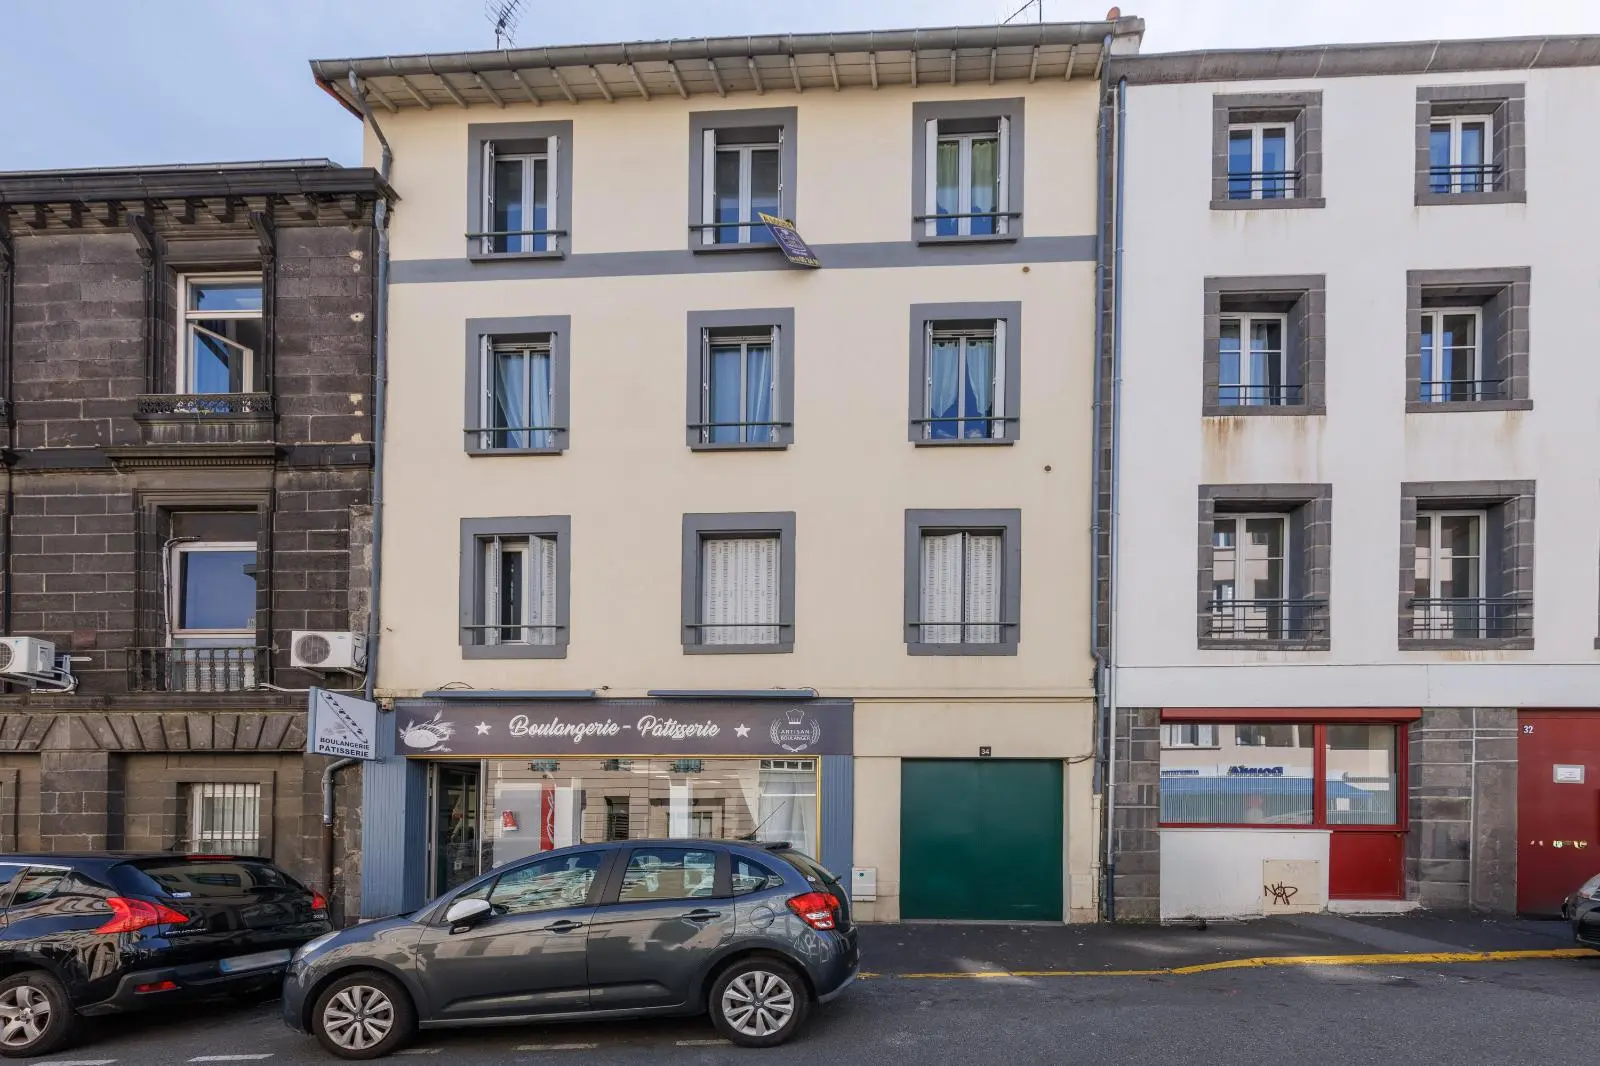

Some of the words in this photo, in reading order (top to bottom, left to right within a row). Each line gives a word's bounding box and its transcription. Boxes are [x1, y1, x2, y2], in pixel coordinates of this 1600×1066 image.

[508, 714, 620, 744] Boulangerie
[636, 714, 720, 740] Pâtisserie
[1523, 725, 1534, 734] 32
[319, 744, 369, 758] PATISSERIE
[320, 737, 370, 751] BOULANGERIE
